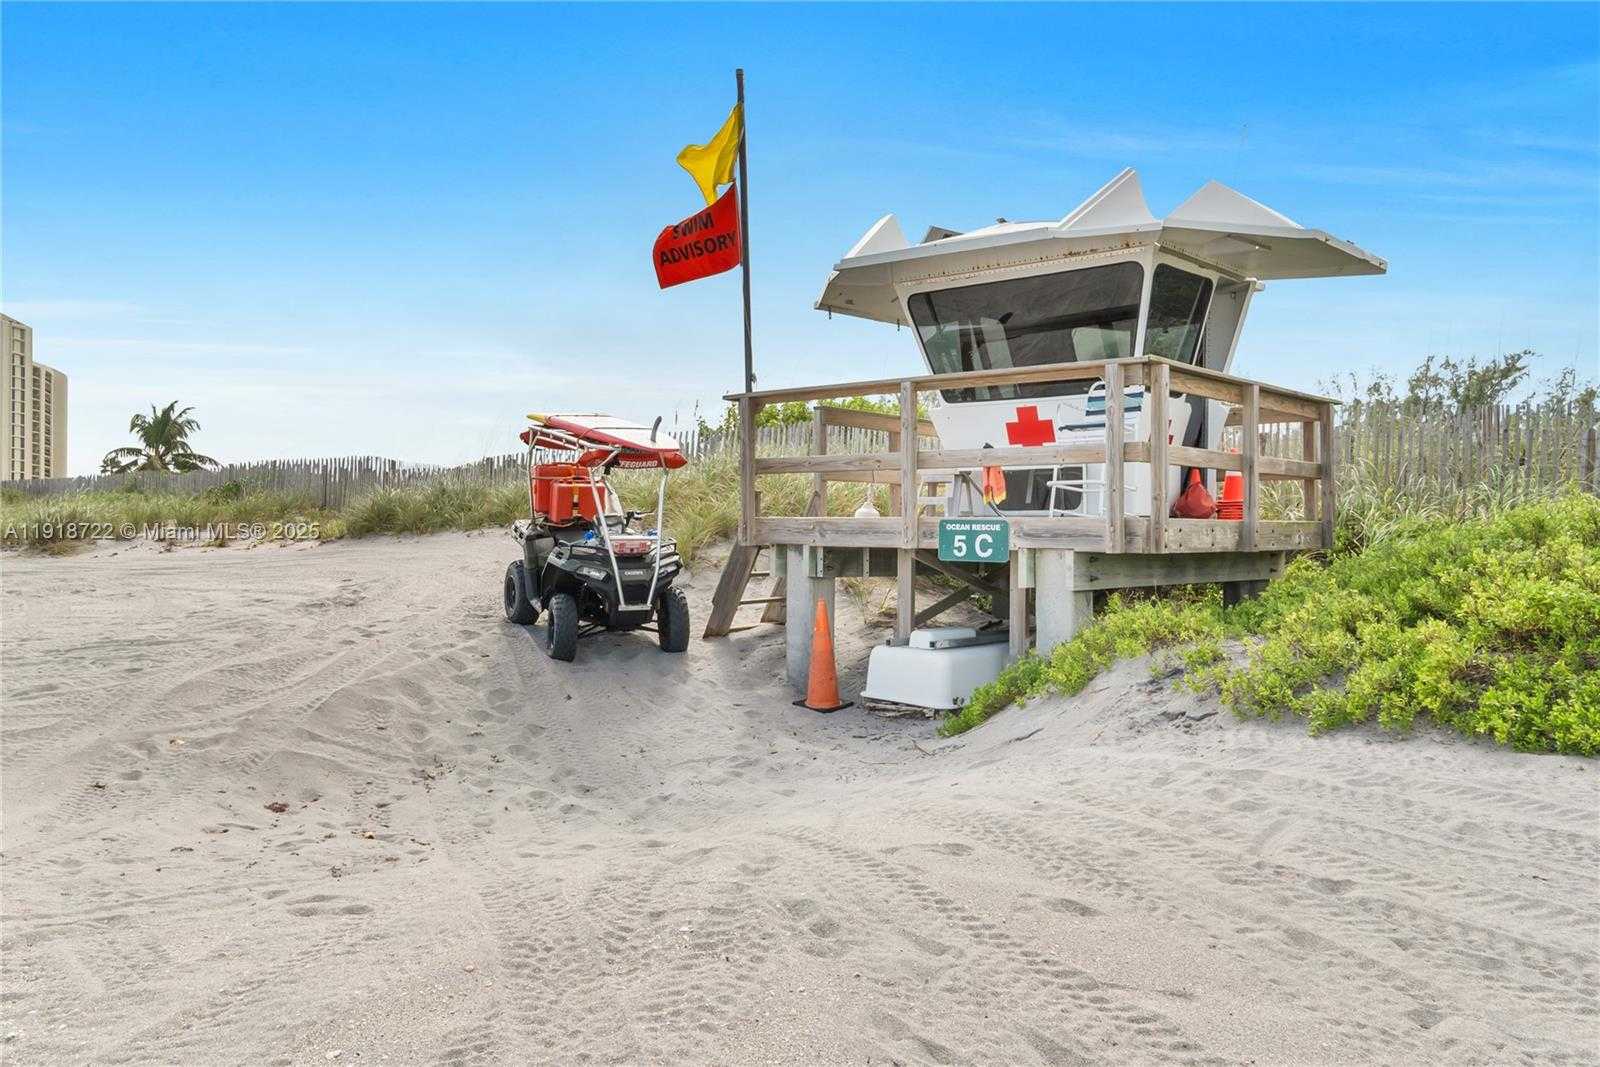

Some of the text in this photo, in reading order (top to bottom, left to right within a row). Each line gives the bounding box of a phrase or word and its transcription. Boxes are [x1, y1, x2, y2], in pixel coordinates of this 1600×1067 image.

[672, 212, 714, 239] SWIM
[660, 231, 736, 265] ADVISORY
[946, 523, 1001, 531] OCEAN RESCUE
[953, 533, 993, 558] 5 C
